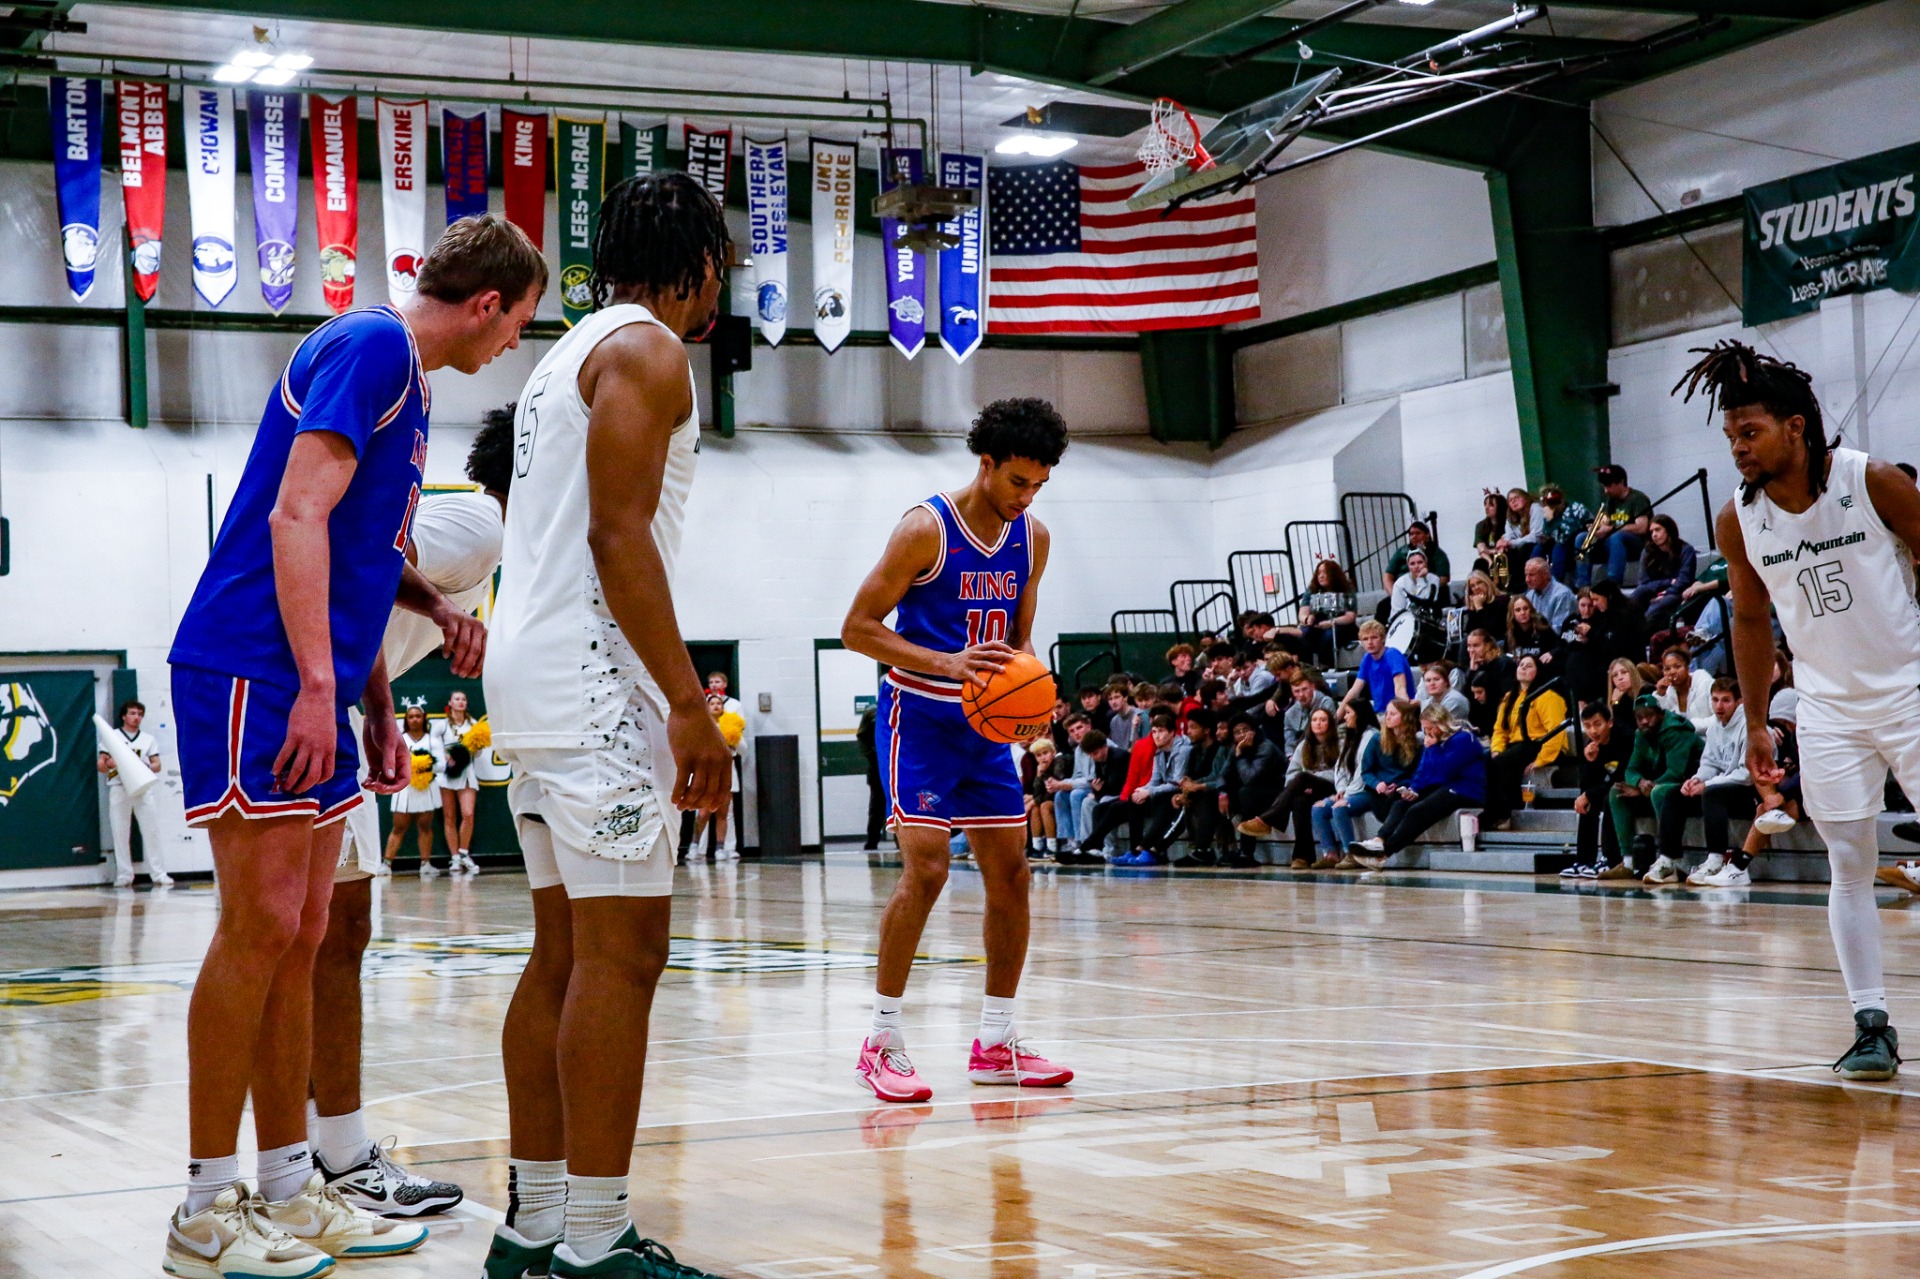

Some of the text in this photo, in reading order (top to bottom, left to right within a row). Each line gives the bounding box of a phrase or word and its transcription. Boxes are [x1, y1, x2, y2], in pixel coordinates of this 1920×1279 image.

[66, 77, 88, 160] BARTON
[120, 81, 142, 187] BELMONT
[143, 82, 165, 156] ABBEY
[199, 89, 220, 175] CHOWAN
[264, 94, 285, 203] CONVERSE
[323, 105, 347, 212] EMMANUEL
[394, 108, 413, 191] ERSKINE
[514, 120, 533, 167] KING
[571, 125, 590, 249] LEES-McRAE
[749, 146, 768, 255] SOUTHERN
[766, 147, 787, 255] WESLEYAN
[816, 152, 833, 192] UNC
[1759, 173, 1915, 251] STUDENTS
[961, 163, 979, 274] UNIVERTY
[958, 570, 1017, 600] KING
[1762, 531, 1866, 567] Dunk Mountain
[1796, 560, 1853, 618] 15
[965, 608, 1008, 650] 10
